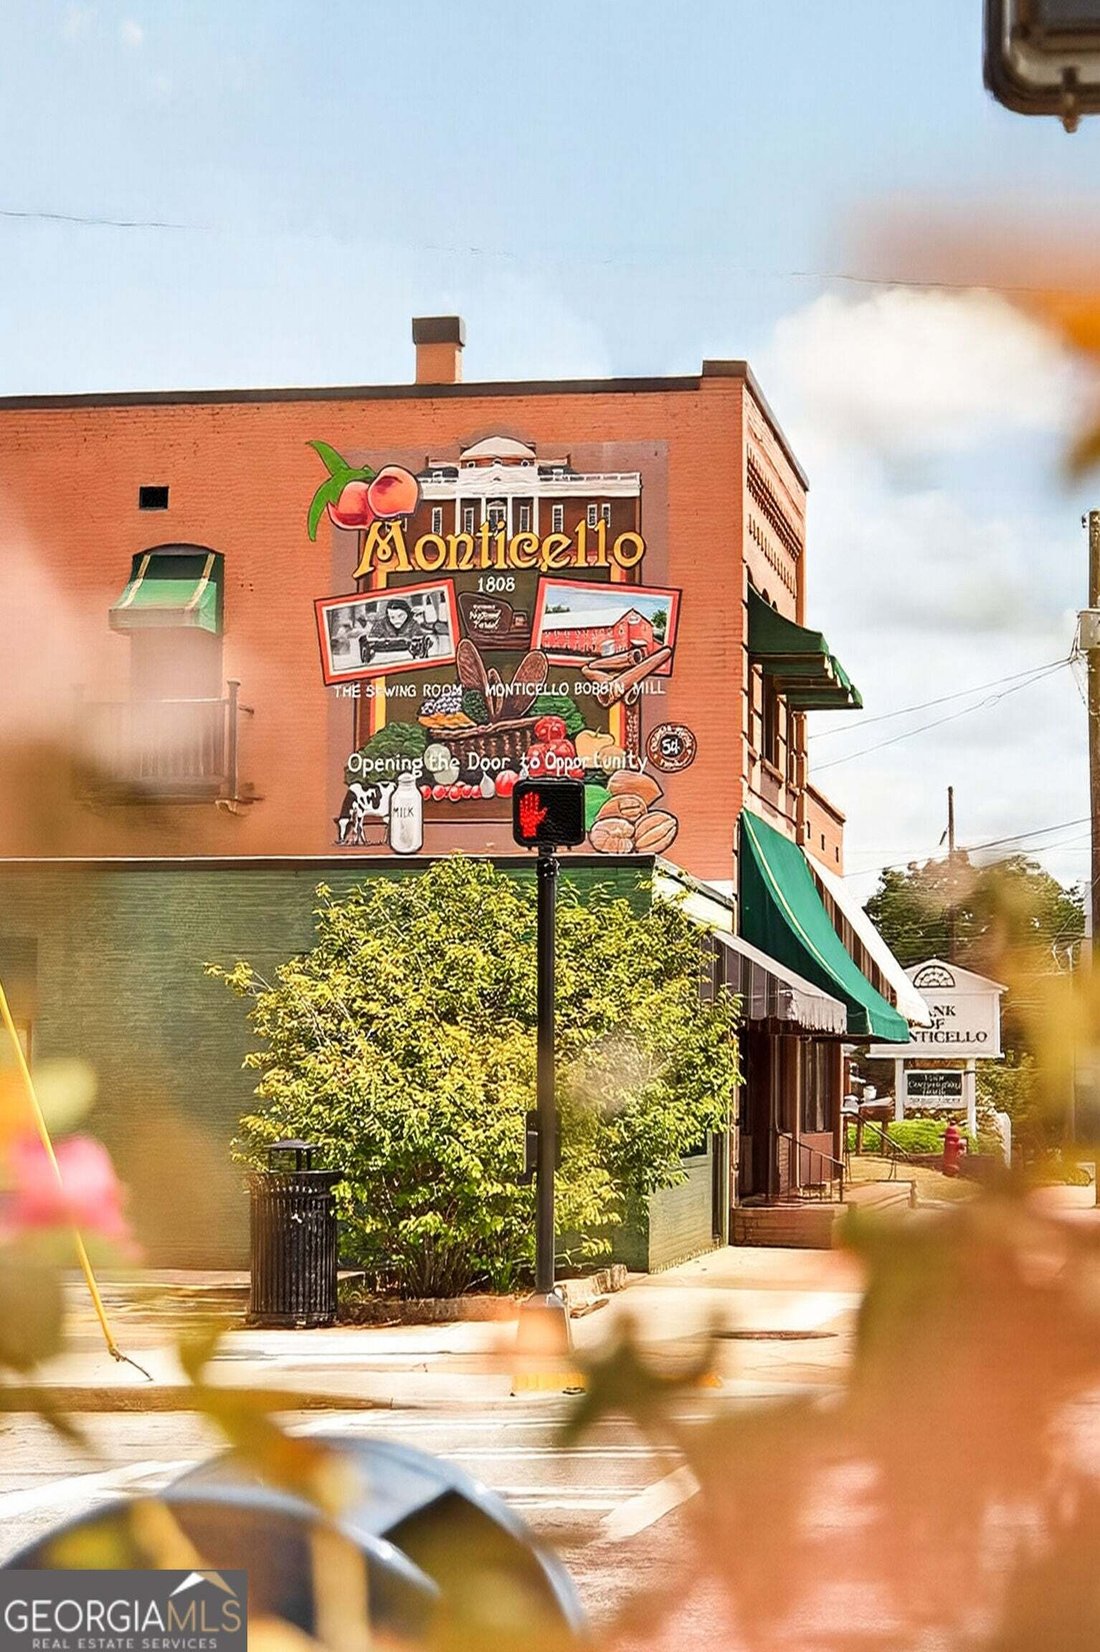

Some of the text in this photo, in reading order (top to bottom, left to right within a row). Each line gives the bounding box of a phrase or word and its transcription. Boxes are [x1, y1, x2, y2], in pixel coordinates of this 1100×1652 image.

[353, 519, 645, 578] Monticello
[478, 576, 515, 592] 1808
[334, 683, 462, 698] THE SEWING ROOM
[485, 681, 666, 696] MONTICELLO BOBBIN MILL
[348, 753, 424, 778] Opening
[429, 753, 460, 772] the
[467, 751, 511, 771] Door
[520, 751, 541, 770] to
[545, 751, 648, 777] Opportunity
[393, 807, 415, 819] MILK
[928, 1005, 956, 1017] NK
[908, 1030, 988, 1043] NTICELLO
